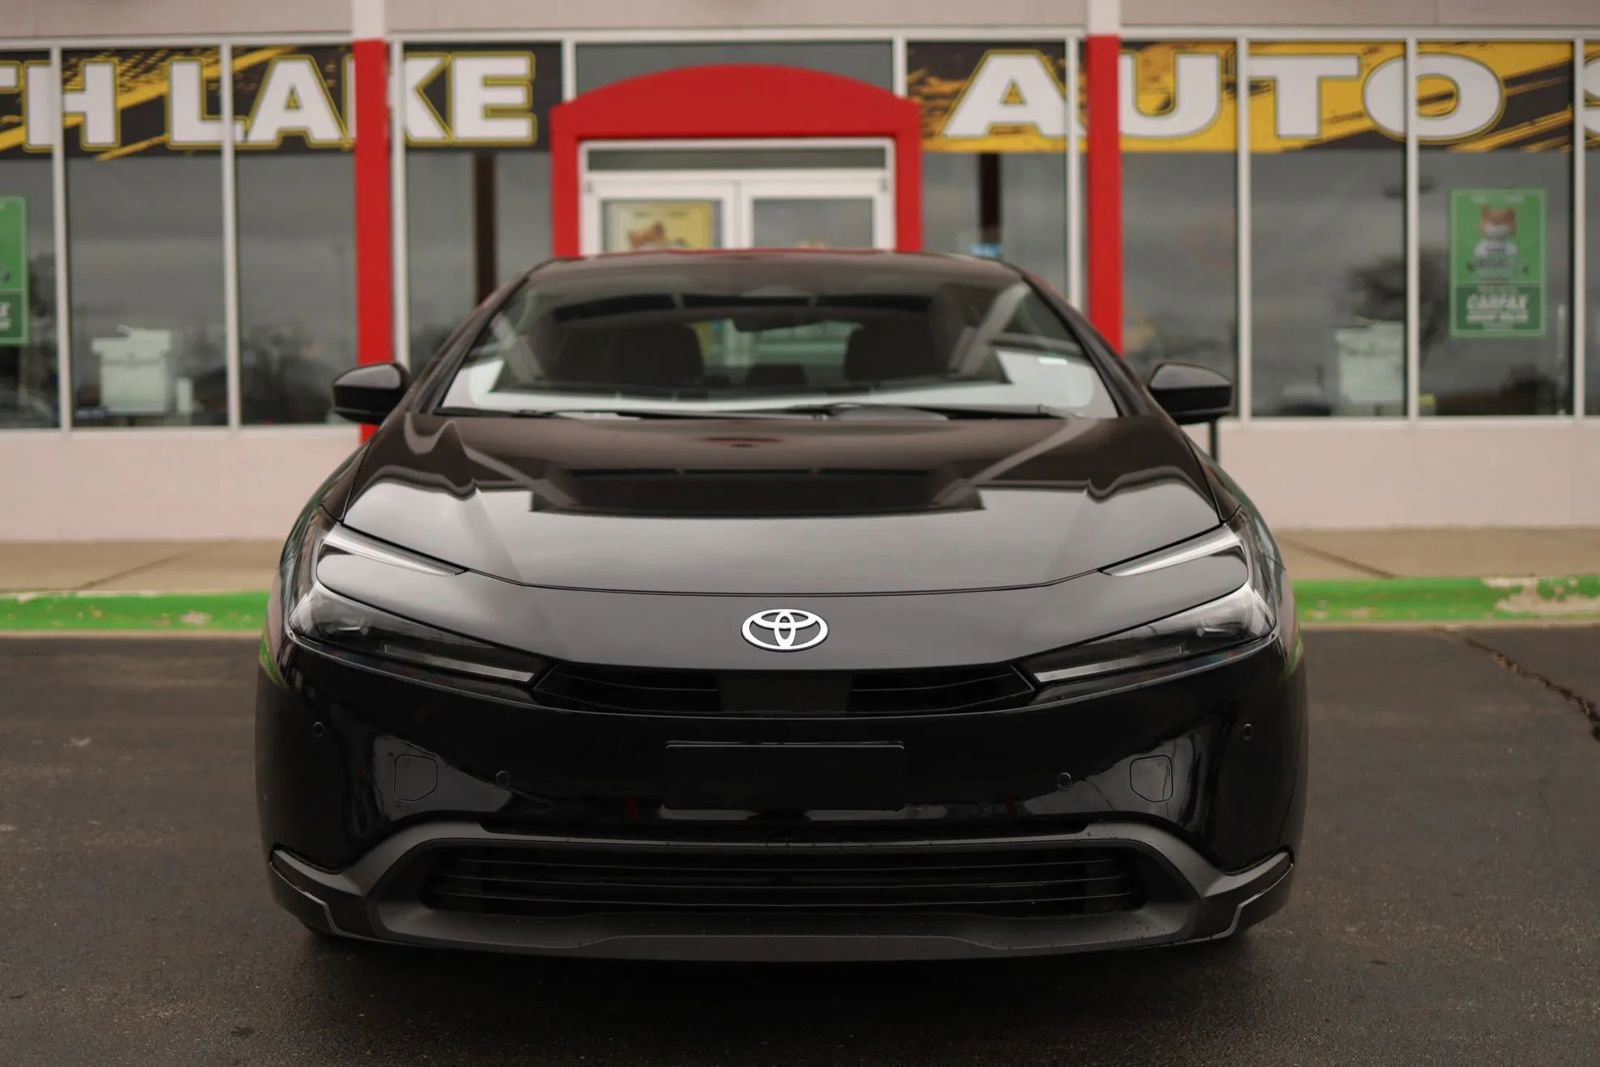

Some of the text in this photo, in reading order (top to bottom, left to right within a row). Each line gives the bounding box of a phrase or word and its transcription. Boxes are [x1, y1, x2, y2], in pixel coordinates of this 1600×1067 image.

[0, 60, 119, 151] H
[167, 51, 537, 149] LAKE
[939, 50, 1505, 140] AUTO
